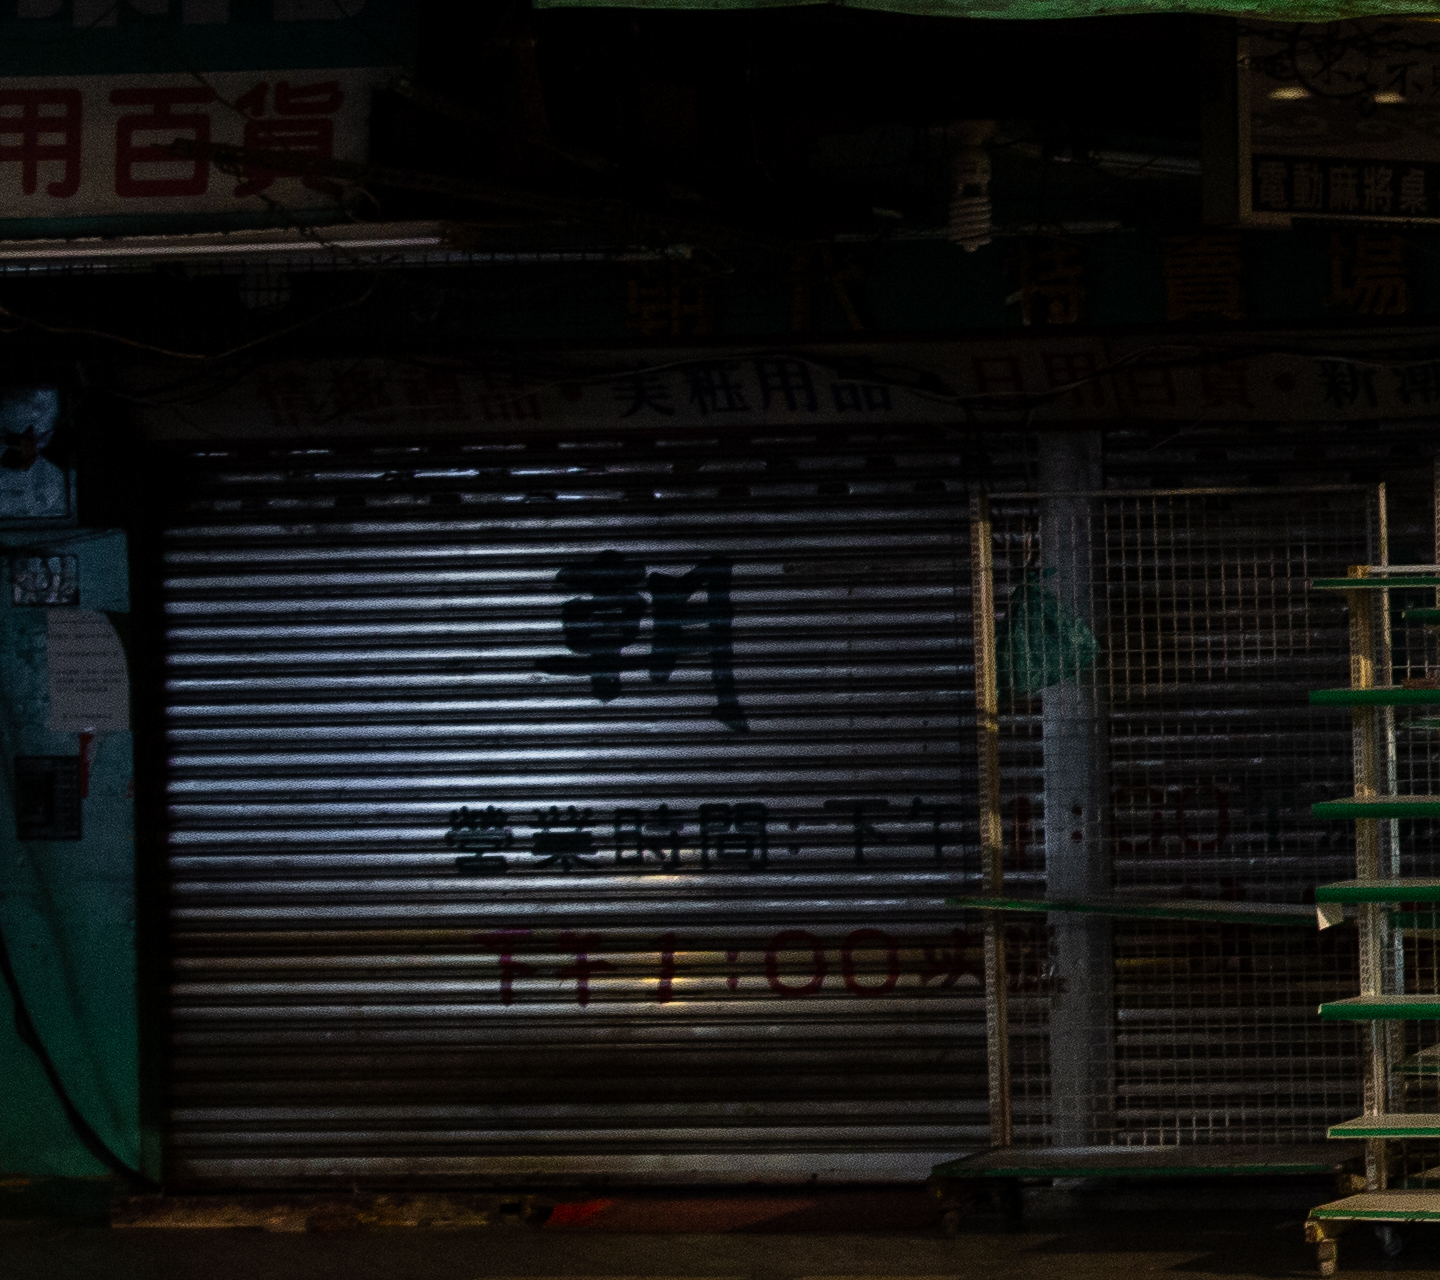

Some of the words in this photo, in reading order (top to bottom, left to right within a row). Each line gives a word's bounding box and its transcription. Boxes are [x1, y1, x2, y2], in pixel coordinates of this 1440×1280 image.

[0, 81, 345, 199] 用百貨
[968, 348, 1255, 411] 日用百貨
[535, 550, 750, 732] 朝
